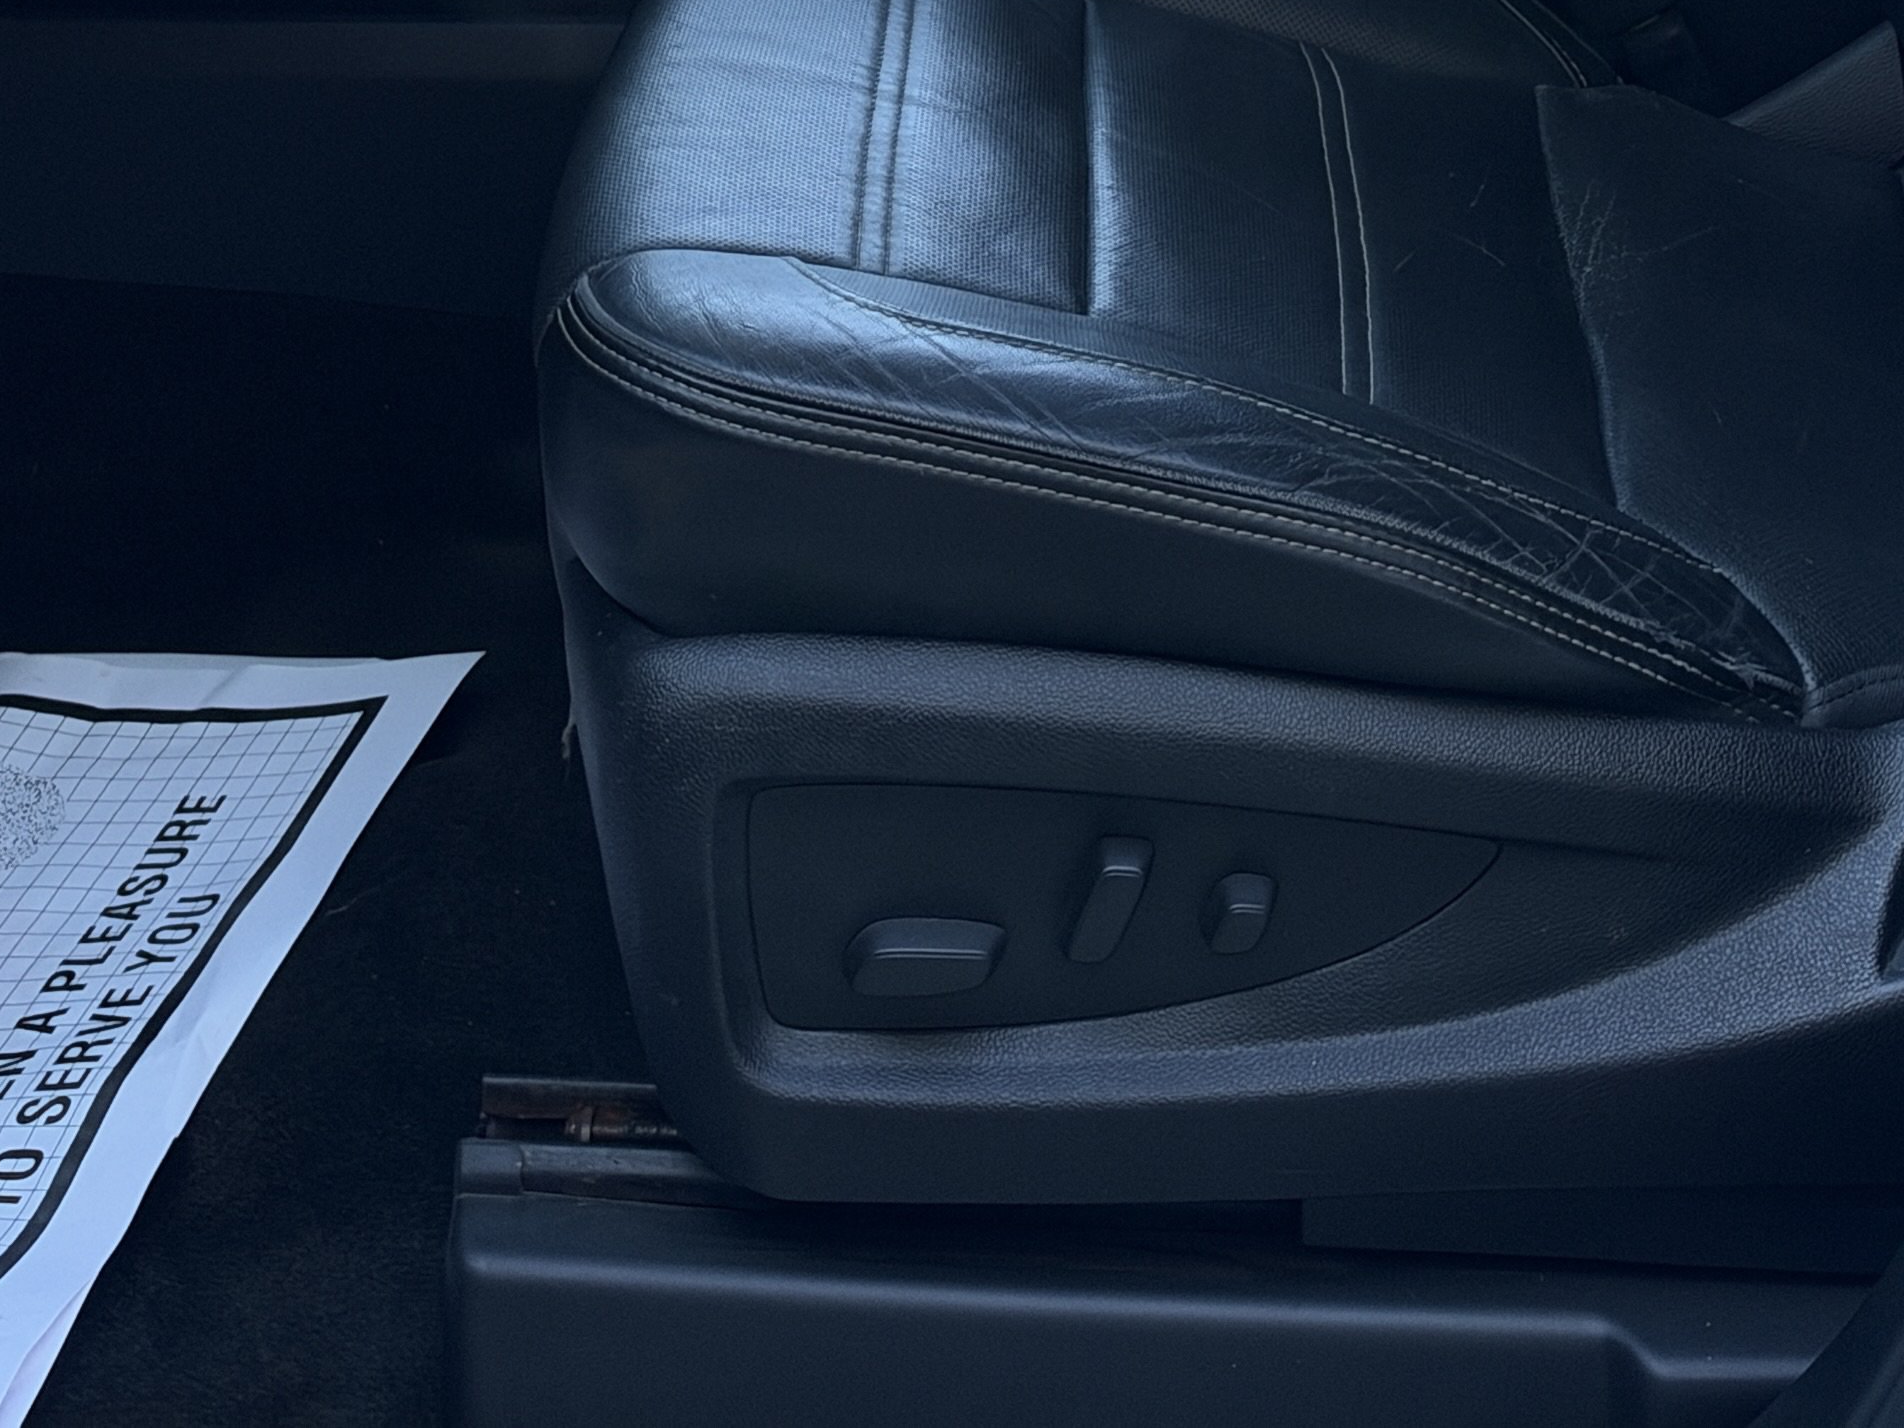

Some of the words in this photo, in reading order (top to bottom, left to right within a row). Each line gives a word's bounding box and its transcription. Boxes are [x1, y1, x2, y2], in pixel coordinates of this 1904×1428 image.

[15, 986, 152, 1124] SERVE
[125, 892, 222, 973] YOU
[18, 1008, 67, 1036] A
[44, 794, 226, 993] PLEASURE
